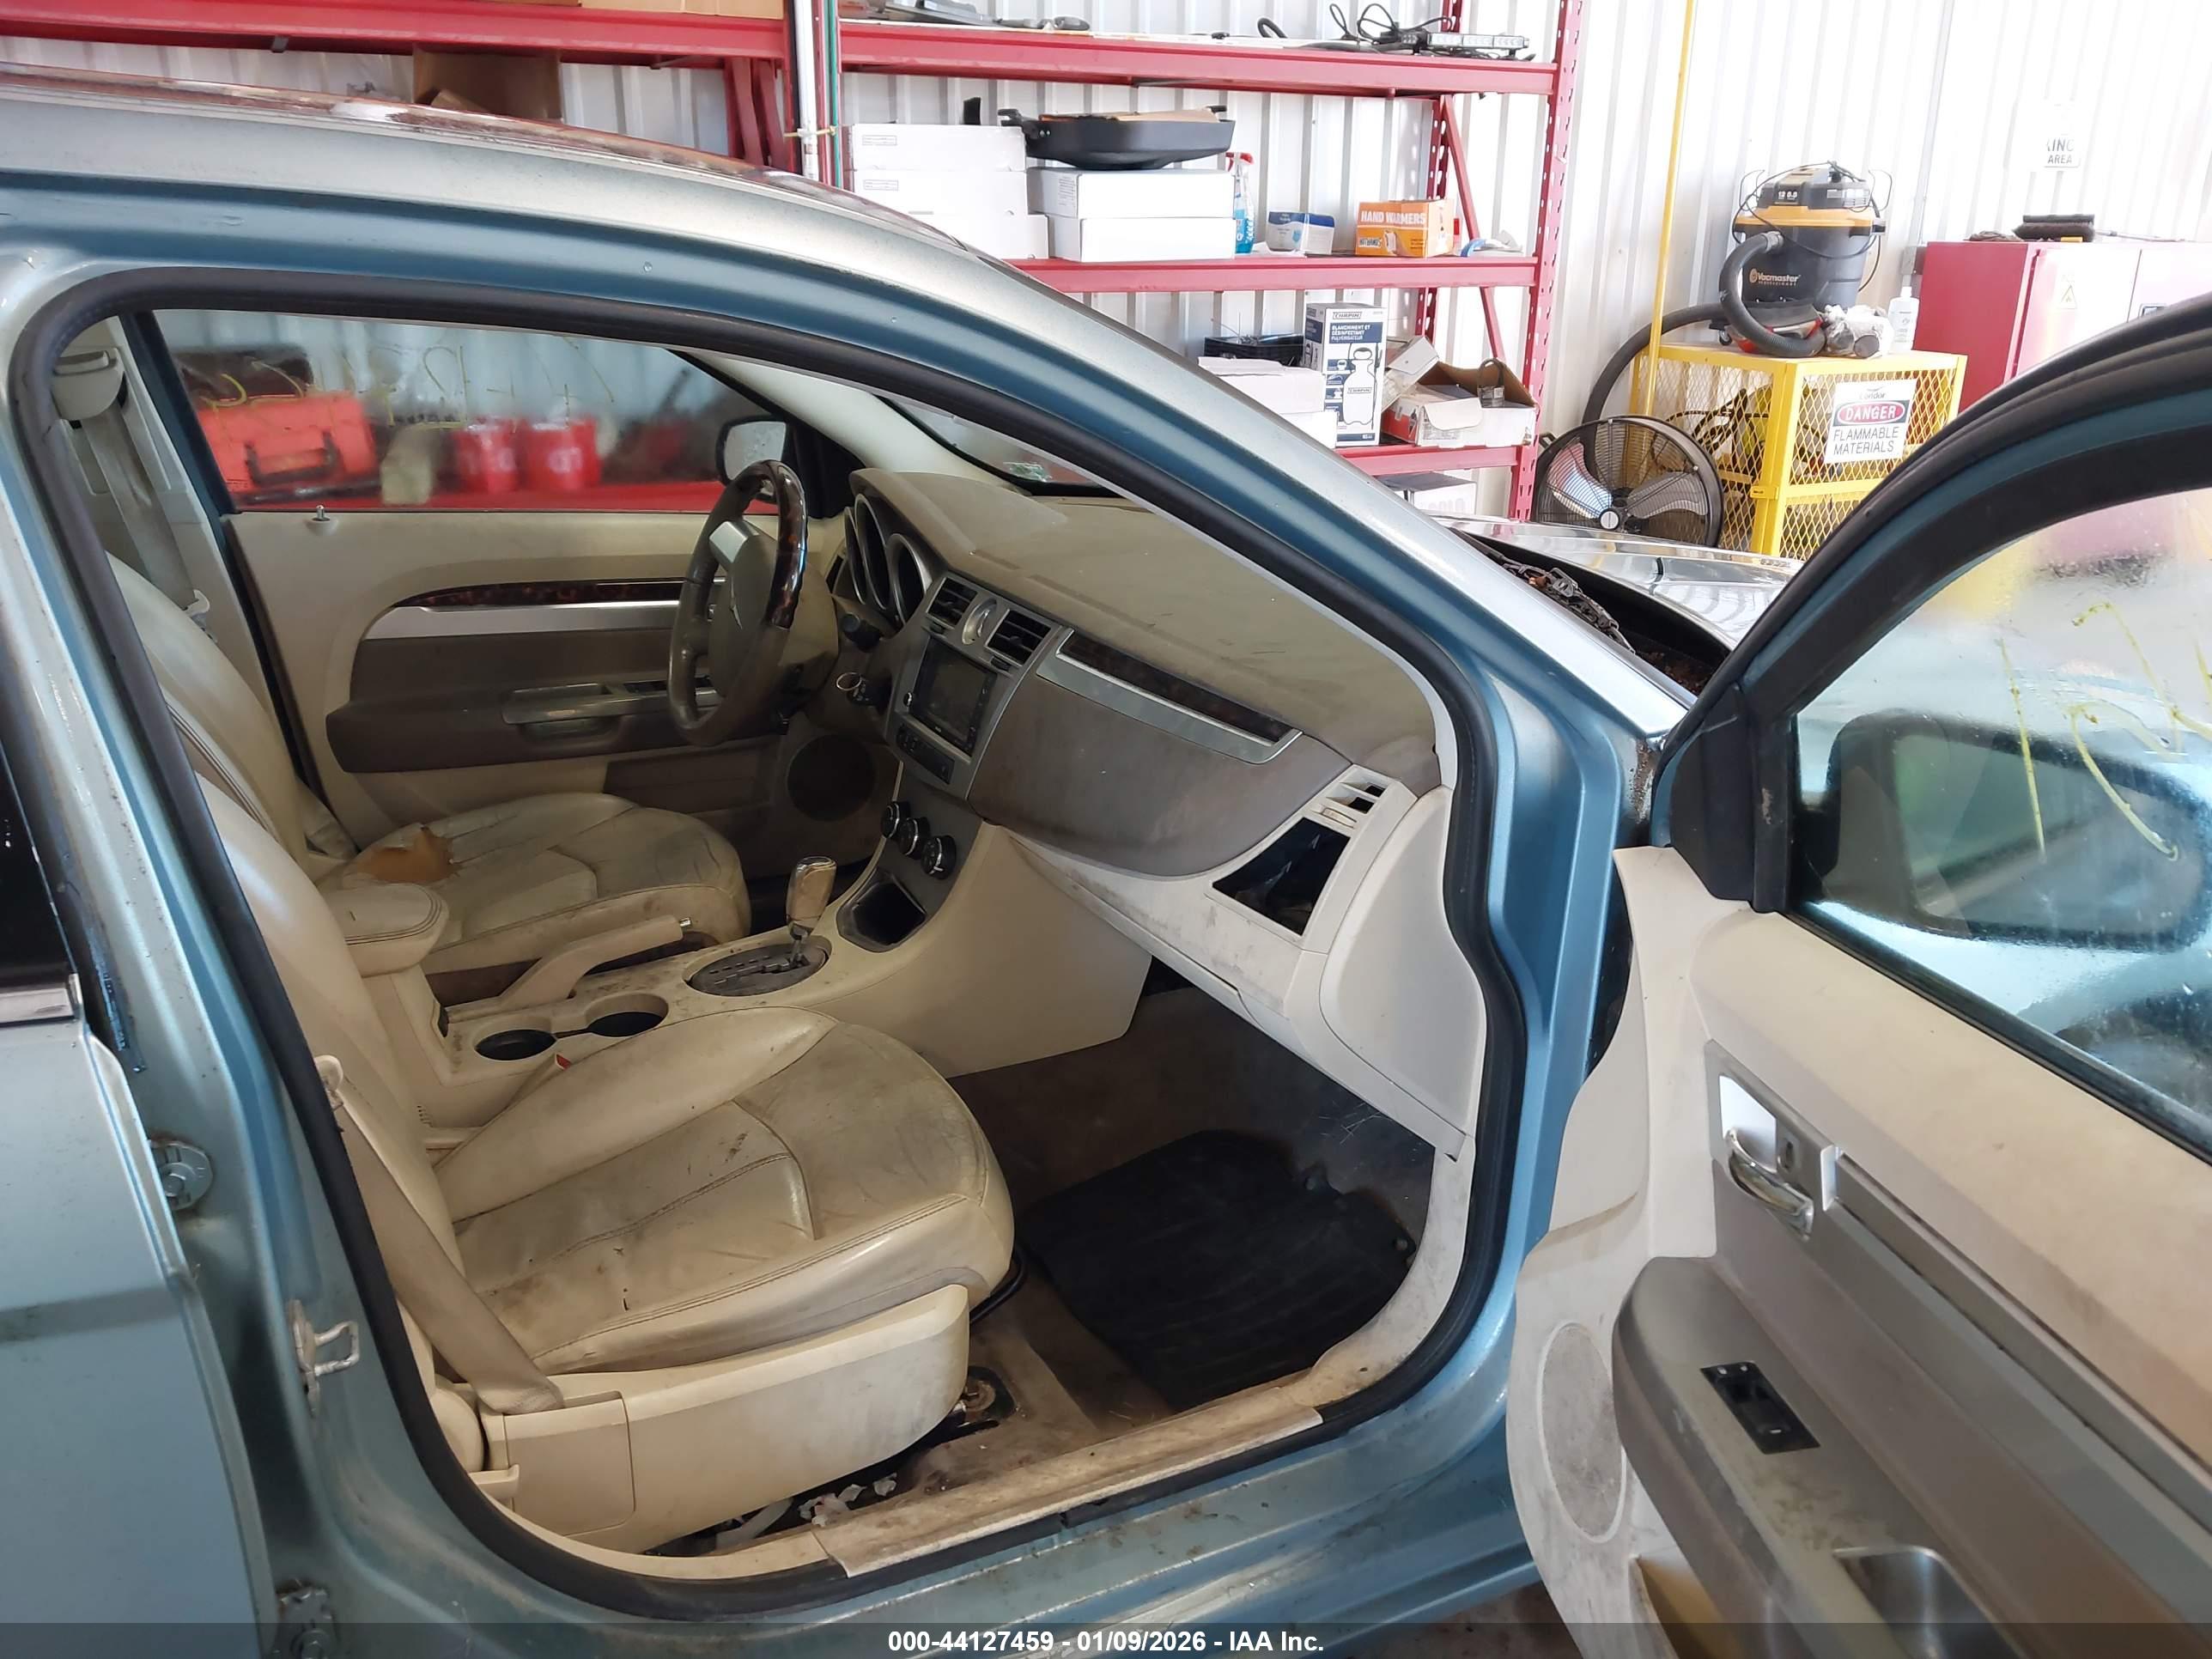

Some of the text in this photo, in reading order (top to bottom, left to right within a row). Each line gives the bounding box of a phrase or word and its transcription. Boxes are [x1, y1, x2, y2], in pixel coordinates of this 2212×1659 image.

[2047, 154, 2072, 164] AREA
[1361, 211, 1425, 224] HAND WARMERS
[1758, 272, 1798, 283] Vacmaster
[1845, 405, 1896, 421] DANGER
[1833, 427, 1899, 441] FLAMMABLE
[1833, 441, 1894, 455] MATERIALS
